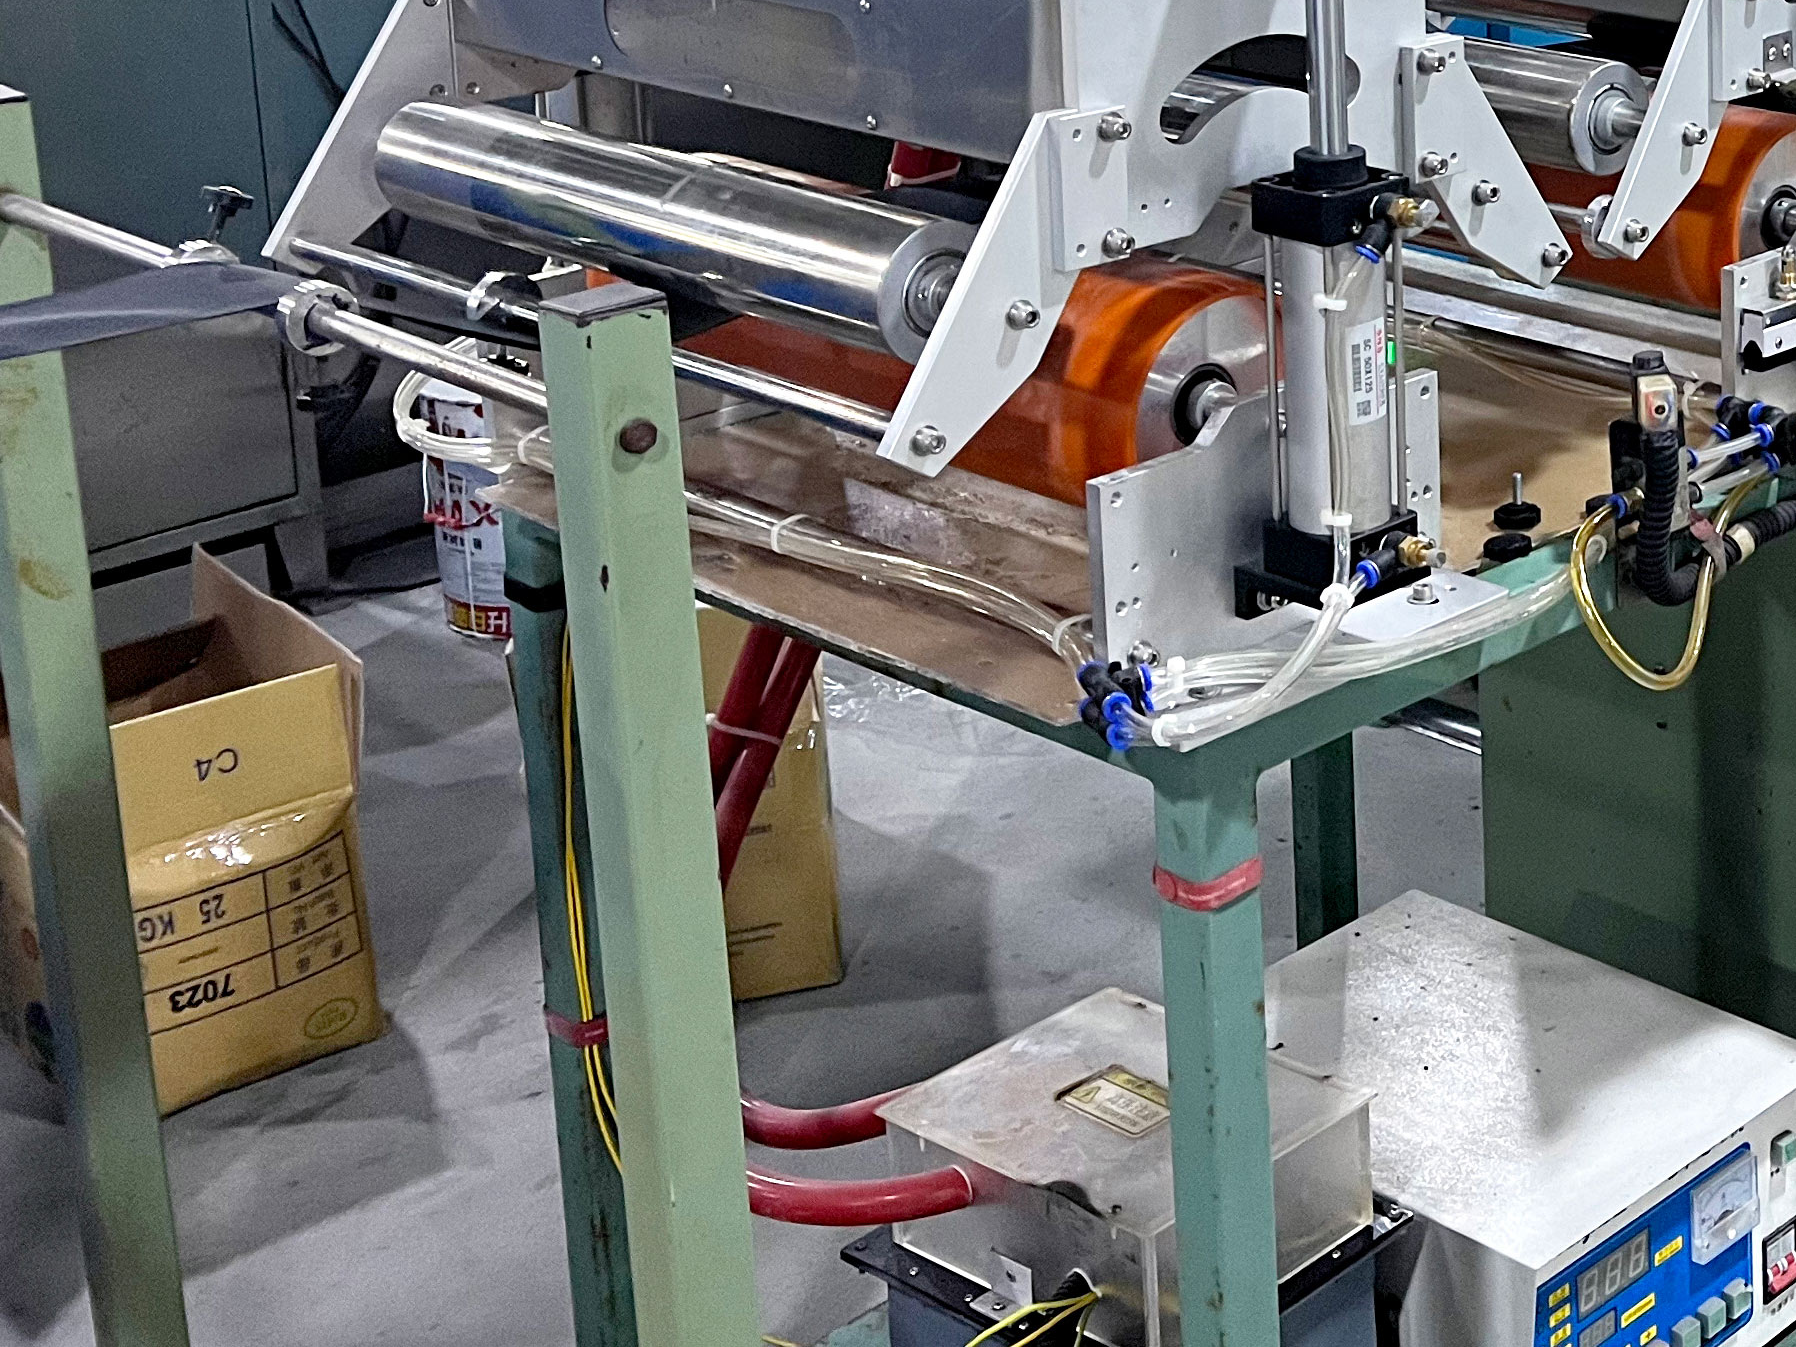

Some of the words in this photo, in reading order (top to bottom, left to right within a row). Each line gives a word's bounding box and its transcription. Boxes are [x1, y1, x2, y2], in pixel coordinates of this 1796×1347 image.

[195, 747, 239, 782] C4
[199, 893, 226, 925] 25
[138, 911, 176, 943] KG
[170, 973, 236, 1013] 7023
